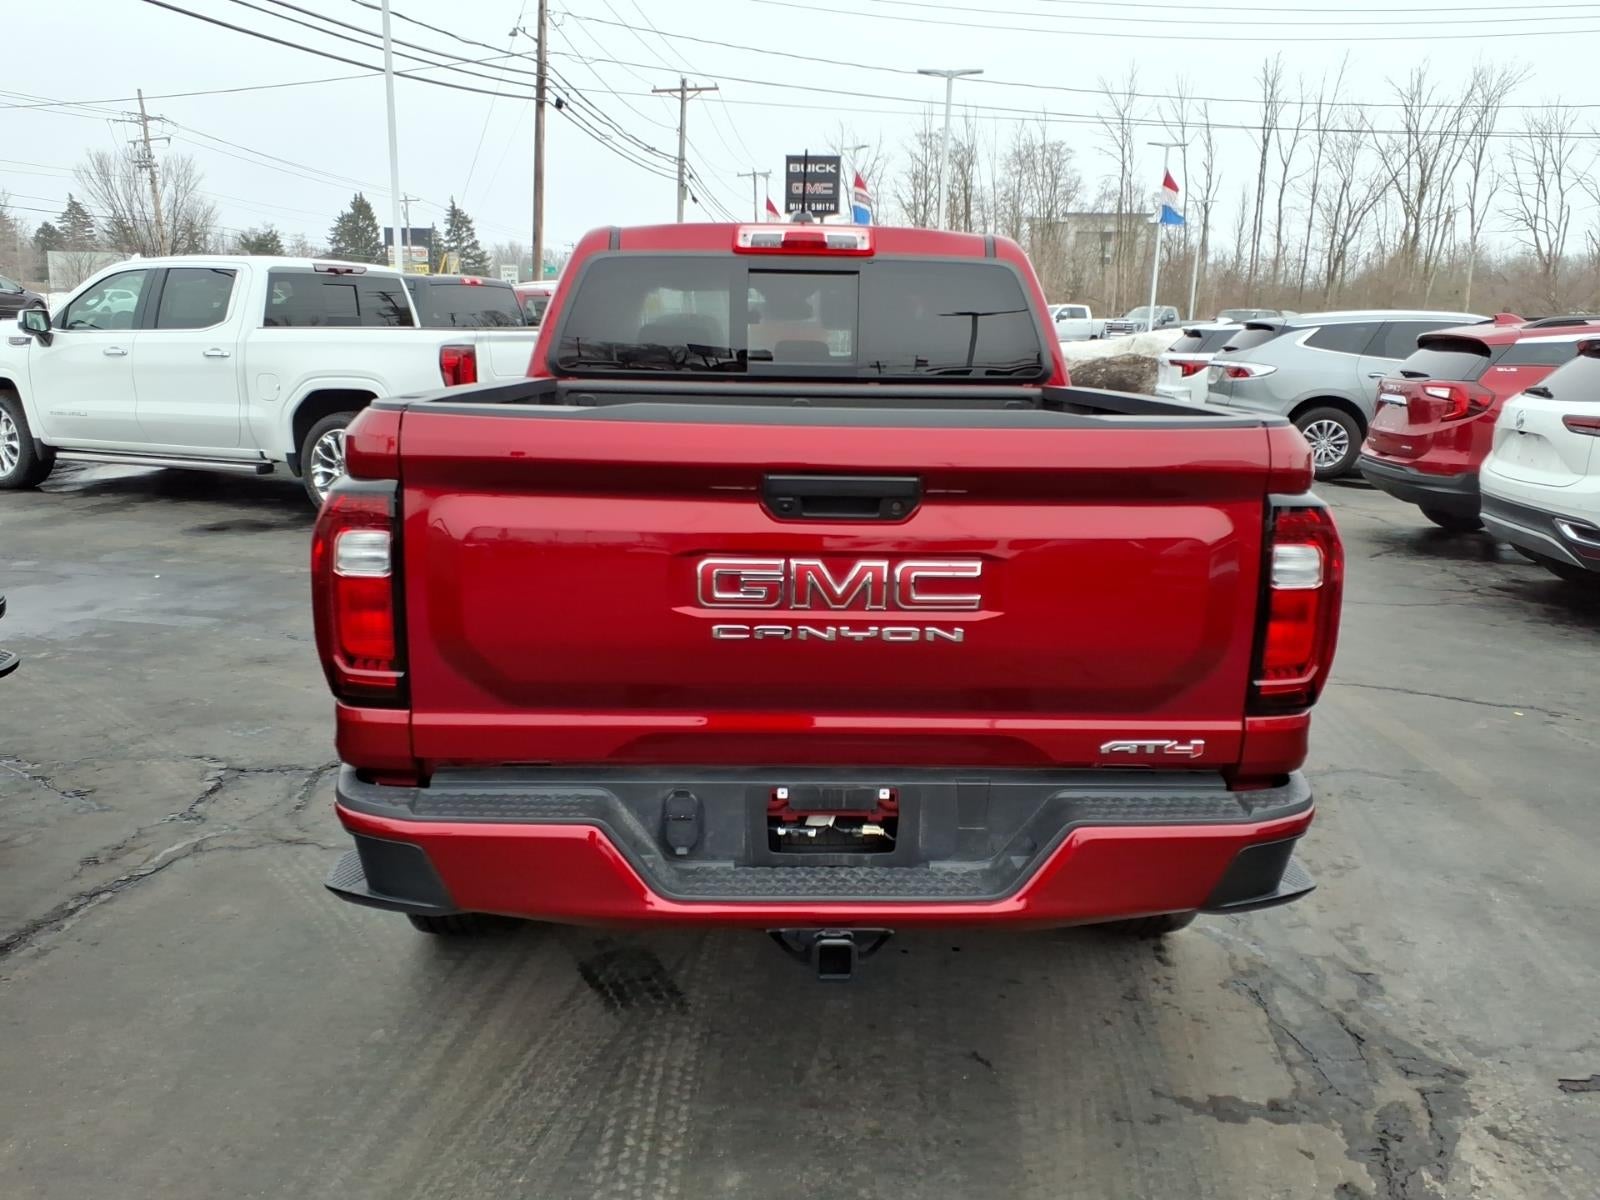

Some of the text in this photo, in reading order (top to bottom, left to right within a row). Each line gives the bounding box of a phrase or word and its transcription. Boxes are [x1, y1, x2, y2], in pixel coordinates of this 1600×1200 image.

[789, 163, 836, 173] BUICK
[792, 182, 833, 194] GMC
[811, 203, 835, 211] SMITH
[696, 557, 982, 610] GMC
[712, 625, 964, 642] CANYON
[1100, 739, 1205, 758] AT4
